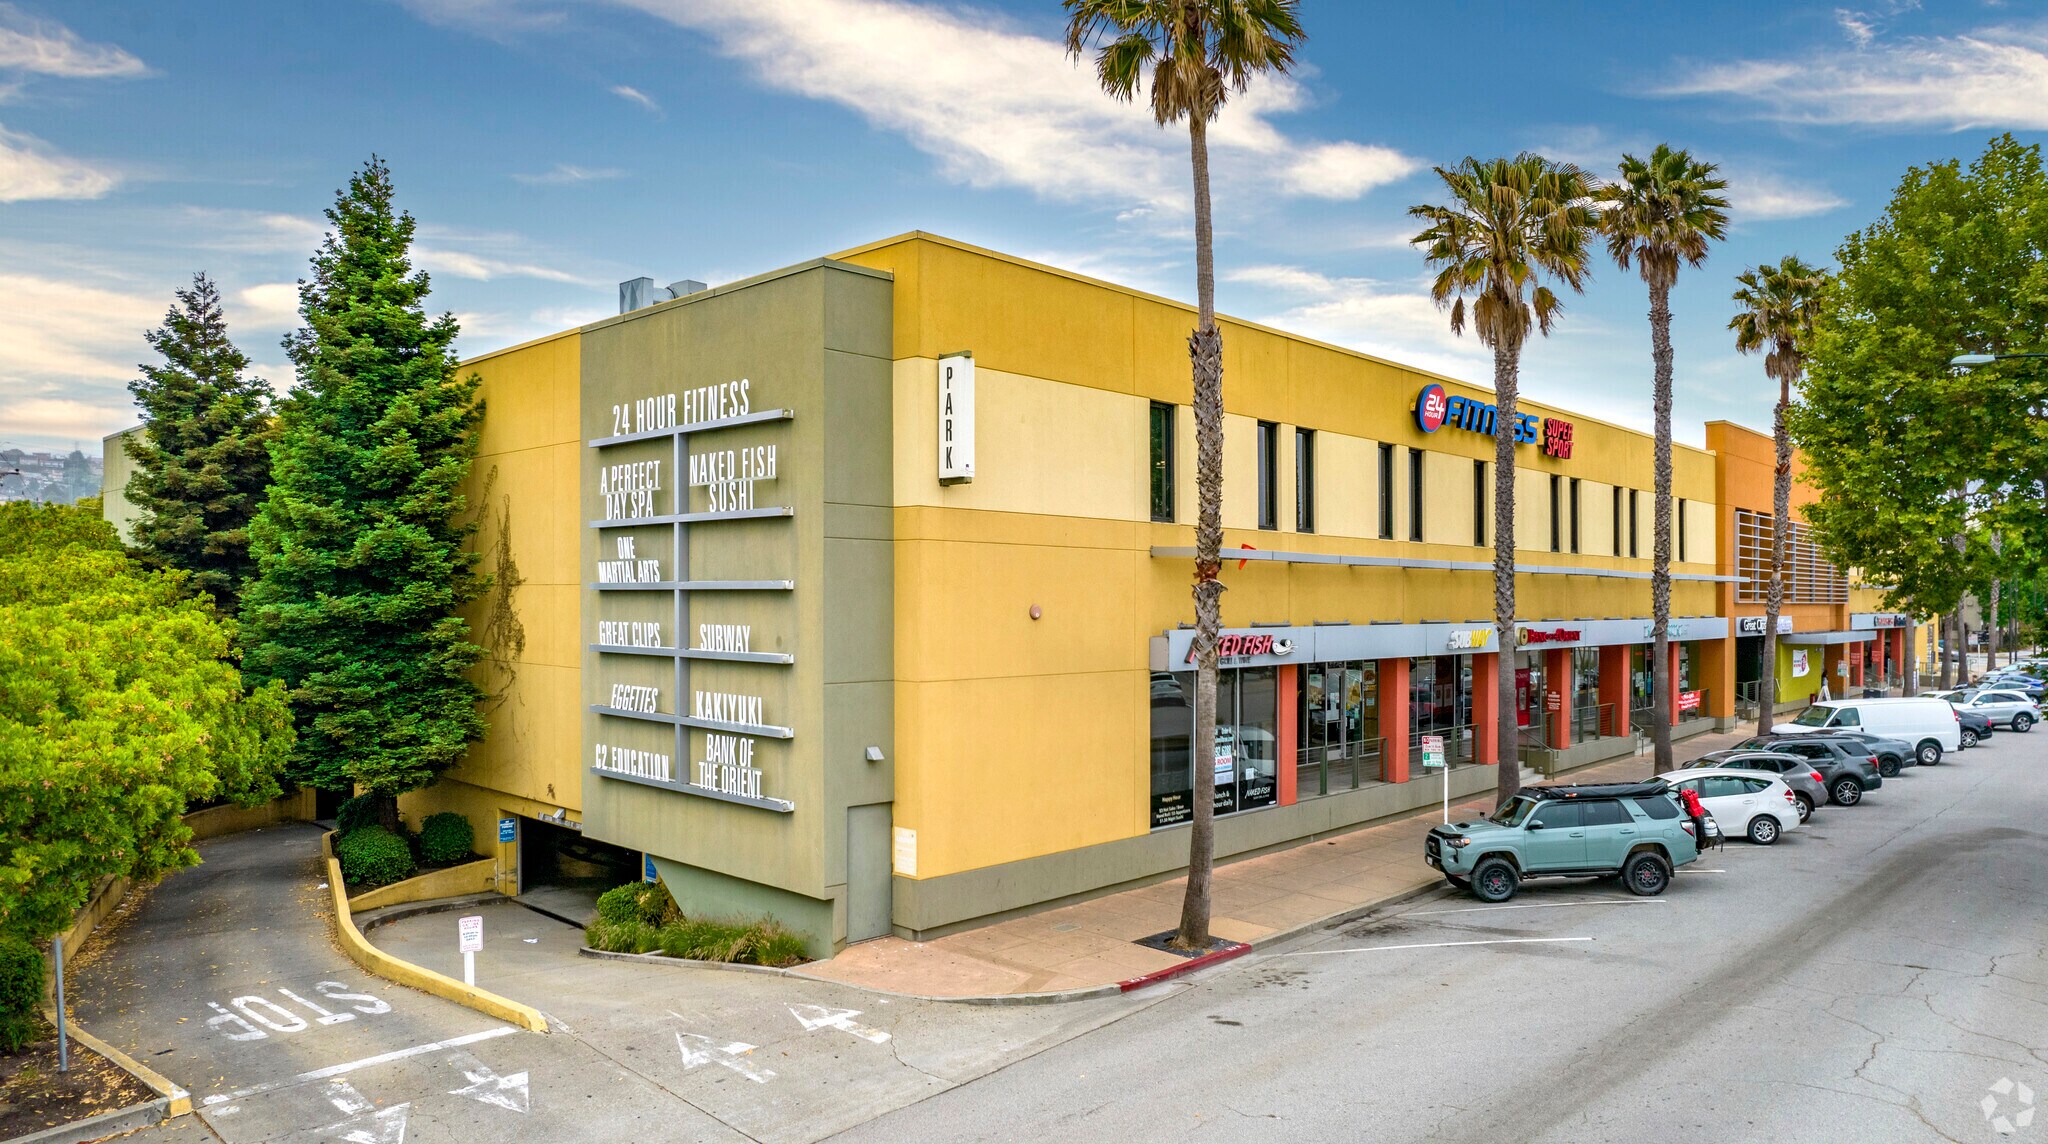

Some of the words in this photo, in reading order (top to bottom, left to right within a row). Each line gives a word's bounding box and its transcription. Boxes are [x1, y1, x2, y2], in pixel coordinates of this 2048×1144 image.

[613, 404, 630, 436] 24
[636, 393, 676, 433] HOUR
[683, 378, 750, 425] FITNESS
[945, 367, 953, 469] PARK
[1426, 394, 1444, 419] 24
[1445, 395, 1539, 444] FITNSS
[1546, 417, 1573, 439] SUPER
[1546, 437, 1573, 460] SPORT
[601, 466, 608, 494] A
[611, 460, 661, 491] PERFECT
[689, 450, 735, 484] NAKED
[742, 445, 776, 478] FISH
[606, 493, 627, 521] DAY
[630, 490, 654, 518] SPA
[709, 480, 754, 513] SUSHI
[617, 536, 635, 560] ONE
[598, 561, 636, 583] MARTIAL
[637, 560, 660, 583] ARTS
[599, 621, 630, 646] GREAT
[632, 621, 661, 648] CLIPS
[699, 624, 751, 653] SUBWAY
[1449, 629, 1492, 650] SUBWAY
[1744, 619, 1757, 631] Great
[1243, 635, 1273, 655] FISH
[611, 684, 659, 713] EGGETTES
[696, 690, 763, 728] KAKIYUKI
[595, 743, 608, 769] C2
[611, 746, 670, 783] EDUCATION
[706, 733, 737, 767] BANK
[740, 737, 754, 768] OF
[699, 761, 718, 791] THE
[721, 765, 762, 800] ORIENT
[1244, 787, 1261, 799] NAKED
[1261, 786, 1271, 794] FISH
[206, 980, 392, 1041] STOP
